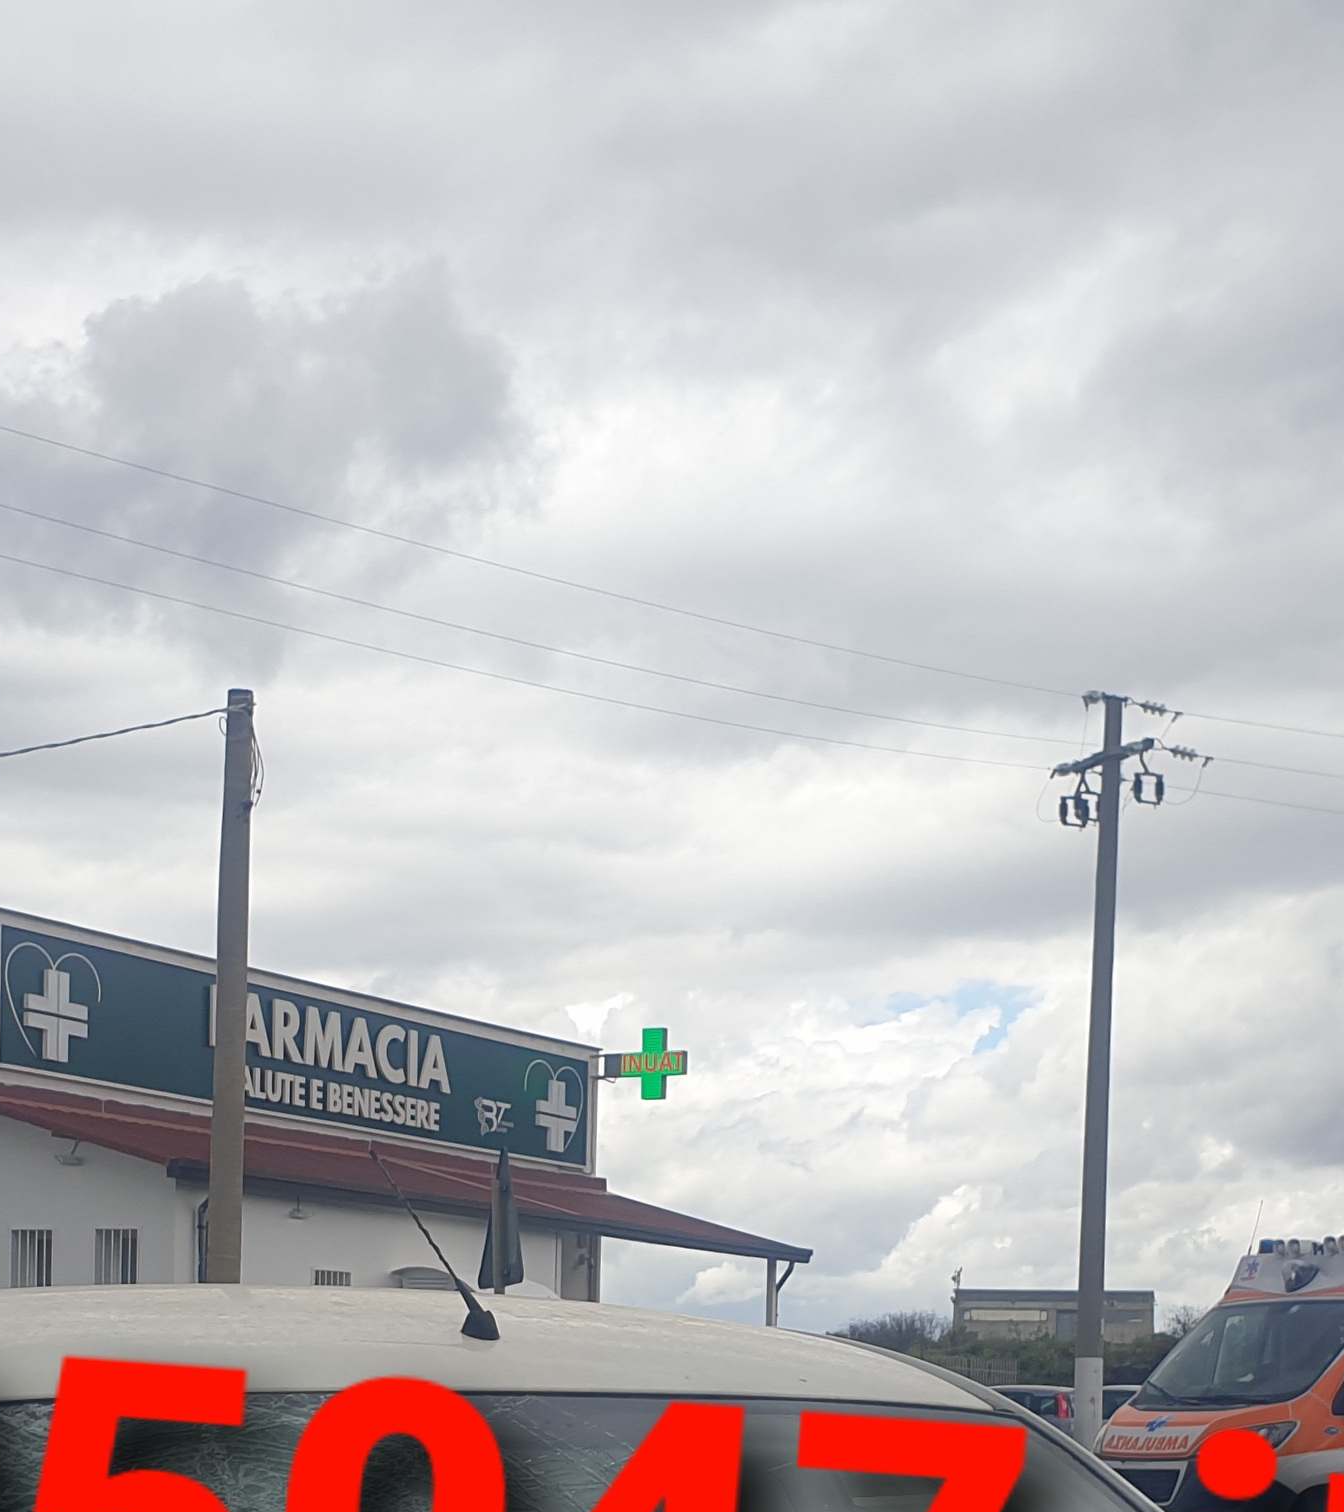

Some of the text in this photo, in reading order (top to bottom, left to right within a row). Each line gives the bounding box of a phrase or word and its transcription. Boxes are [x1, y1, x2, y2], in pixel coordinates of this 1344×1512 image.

[209, 983, 452, 1095] ARMACIA
[622, 1052, 684, 1073] INUAT
[244, 1065, 441, 1132] ALUTE E BENESSERE
